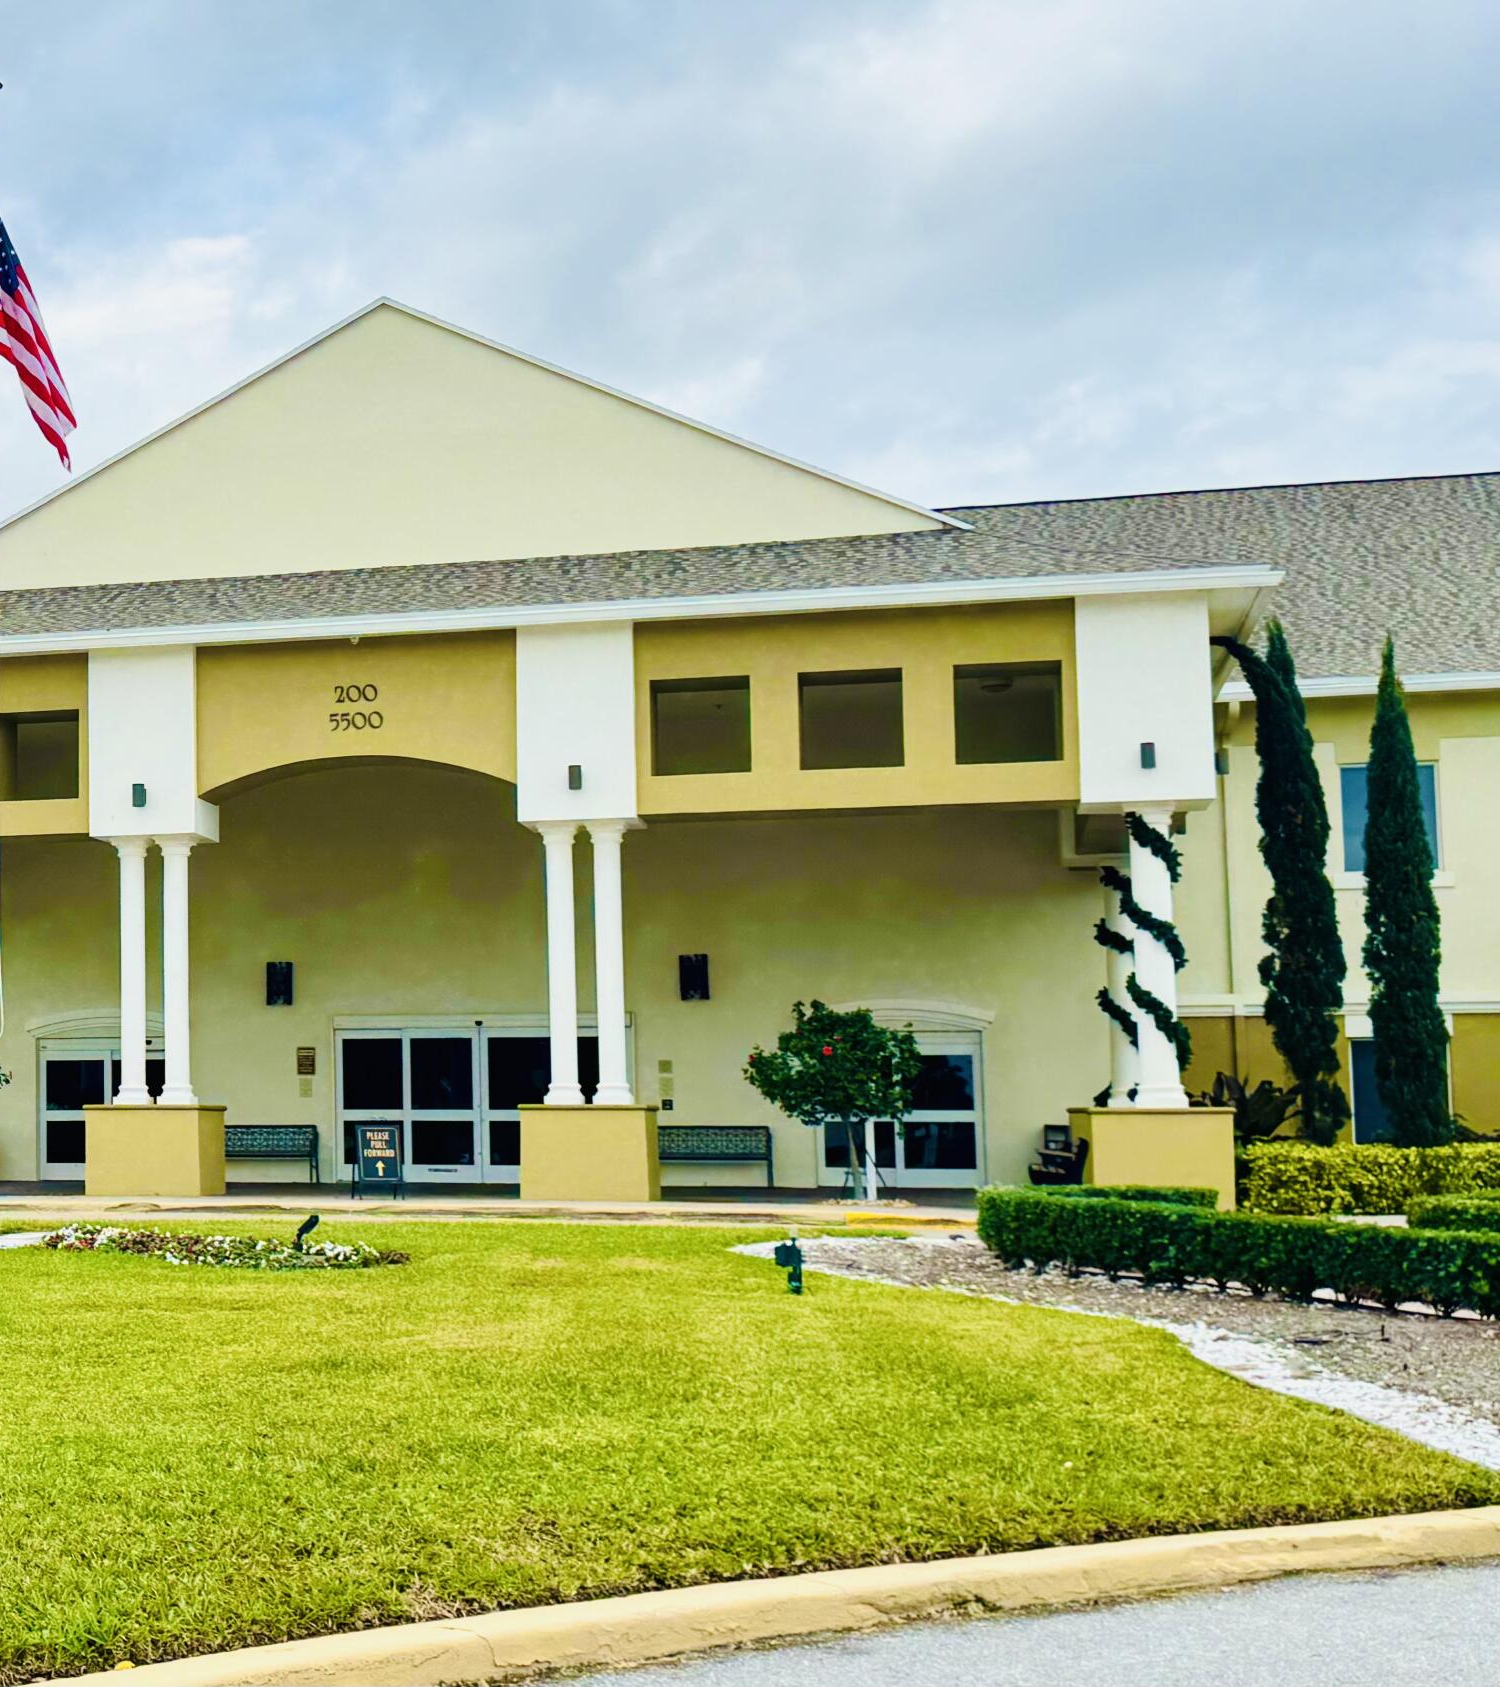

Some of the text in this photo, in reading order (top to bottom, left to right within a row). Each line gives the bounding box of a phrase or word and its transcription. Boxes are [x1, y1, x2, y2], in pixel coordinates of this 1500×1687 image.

[334, 683, 378, 703] 200
[329, 711, 384, 732] 5500
[366, 1131, 389, 1140] PLEASE
[370, 1140, 387, 1148] PULL
[364, 1149, 395, 1157] FORWARD
